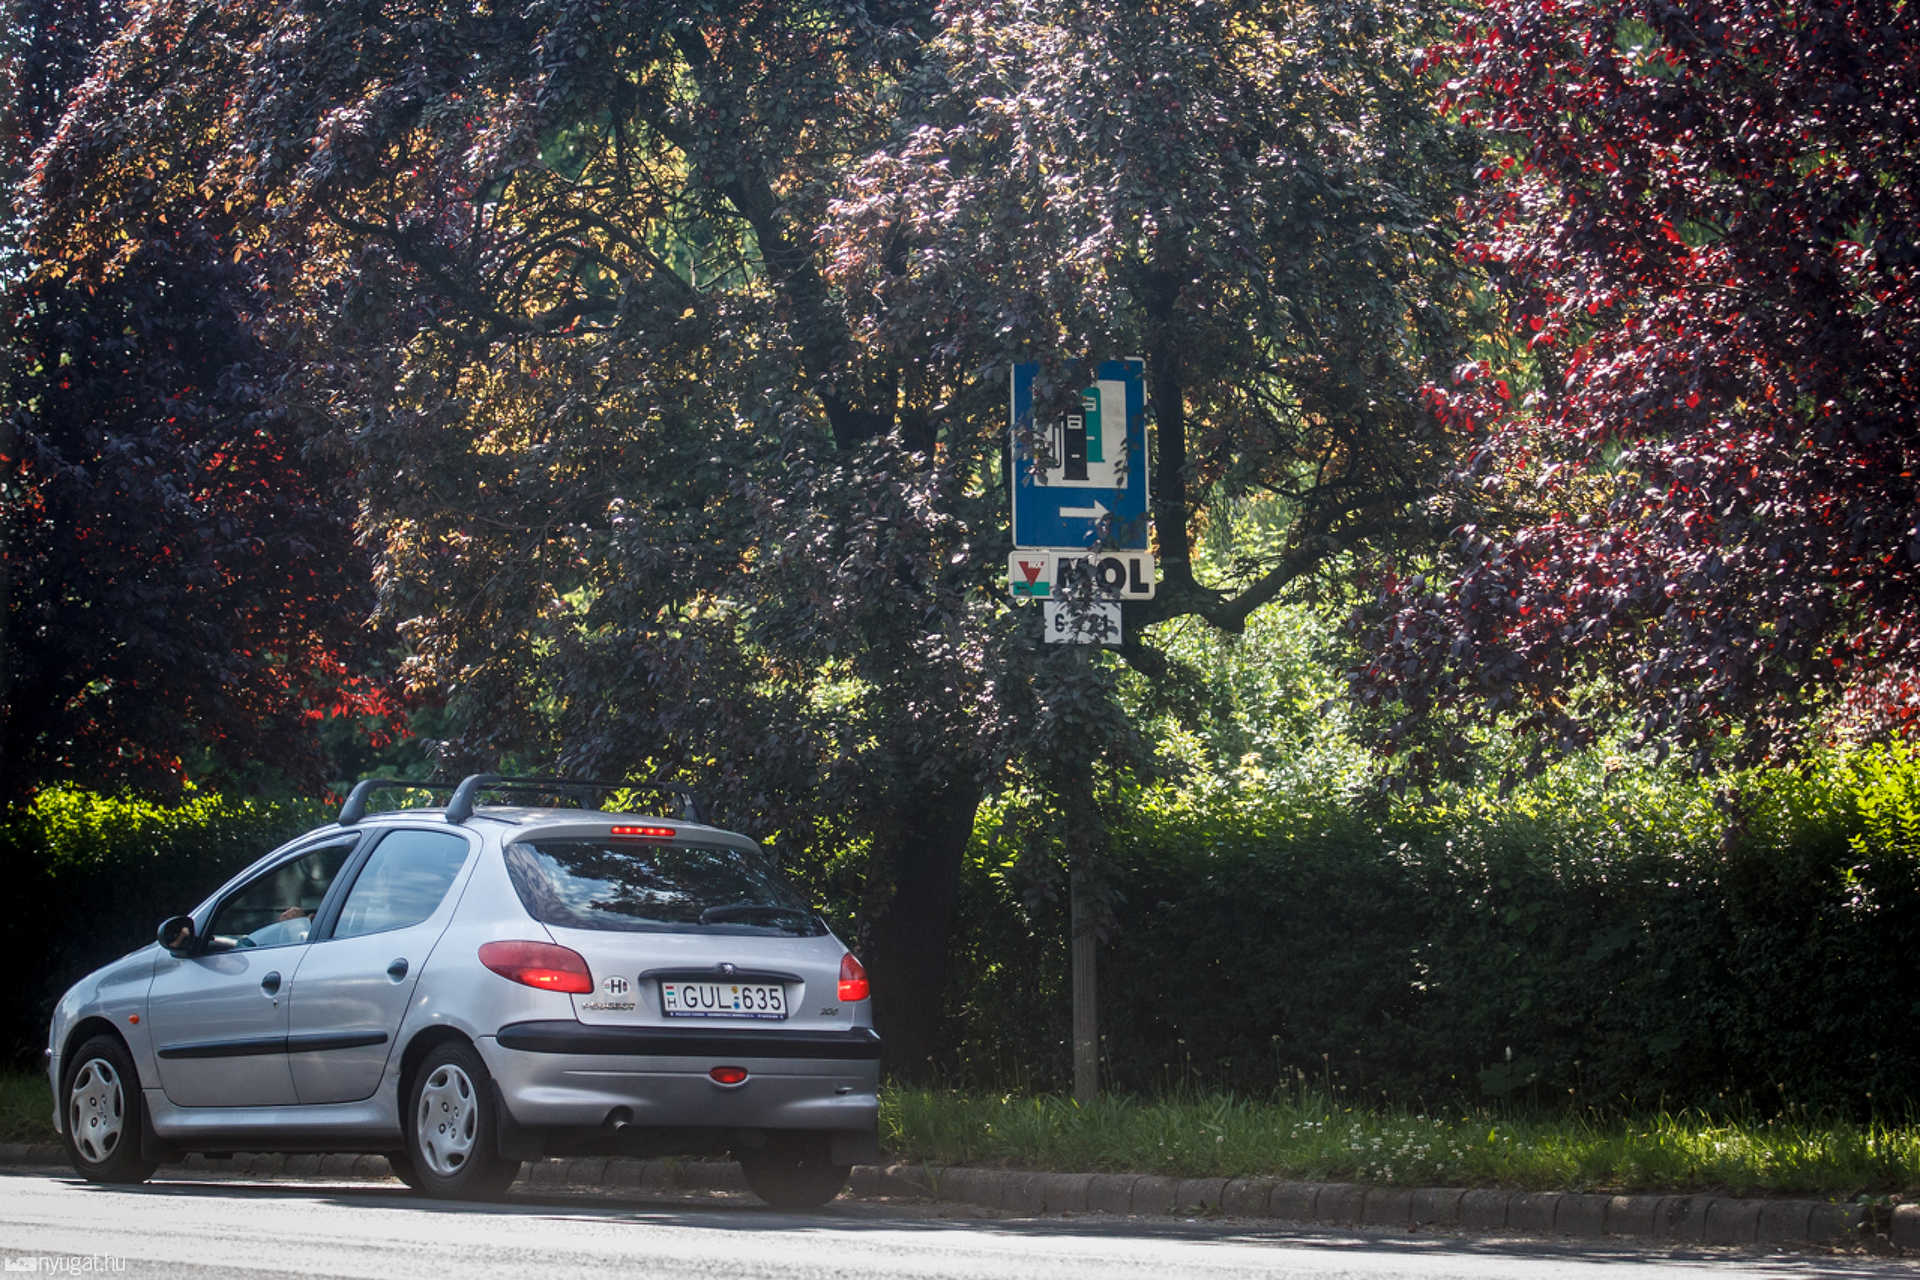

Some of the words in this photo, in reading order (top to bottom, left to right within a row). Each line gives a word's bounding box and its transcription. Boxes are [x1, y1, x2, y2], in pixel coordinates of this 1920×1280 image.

[1056, 557, 1149, 594] MOL
[610, 979, 622, 994] H
[667, 997, 677, 1009] H
